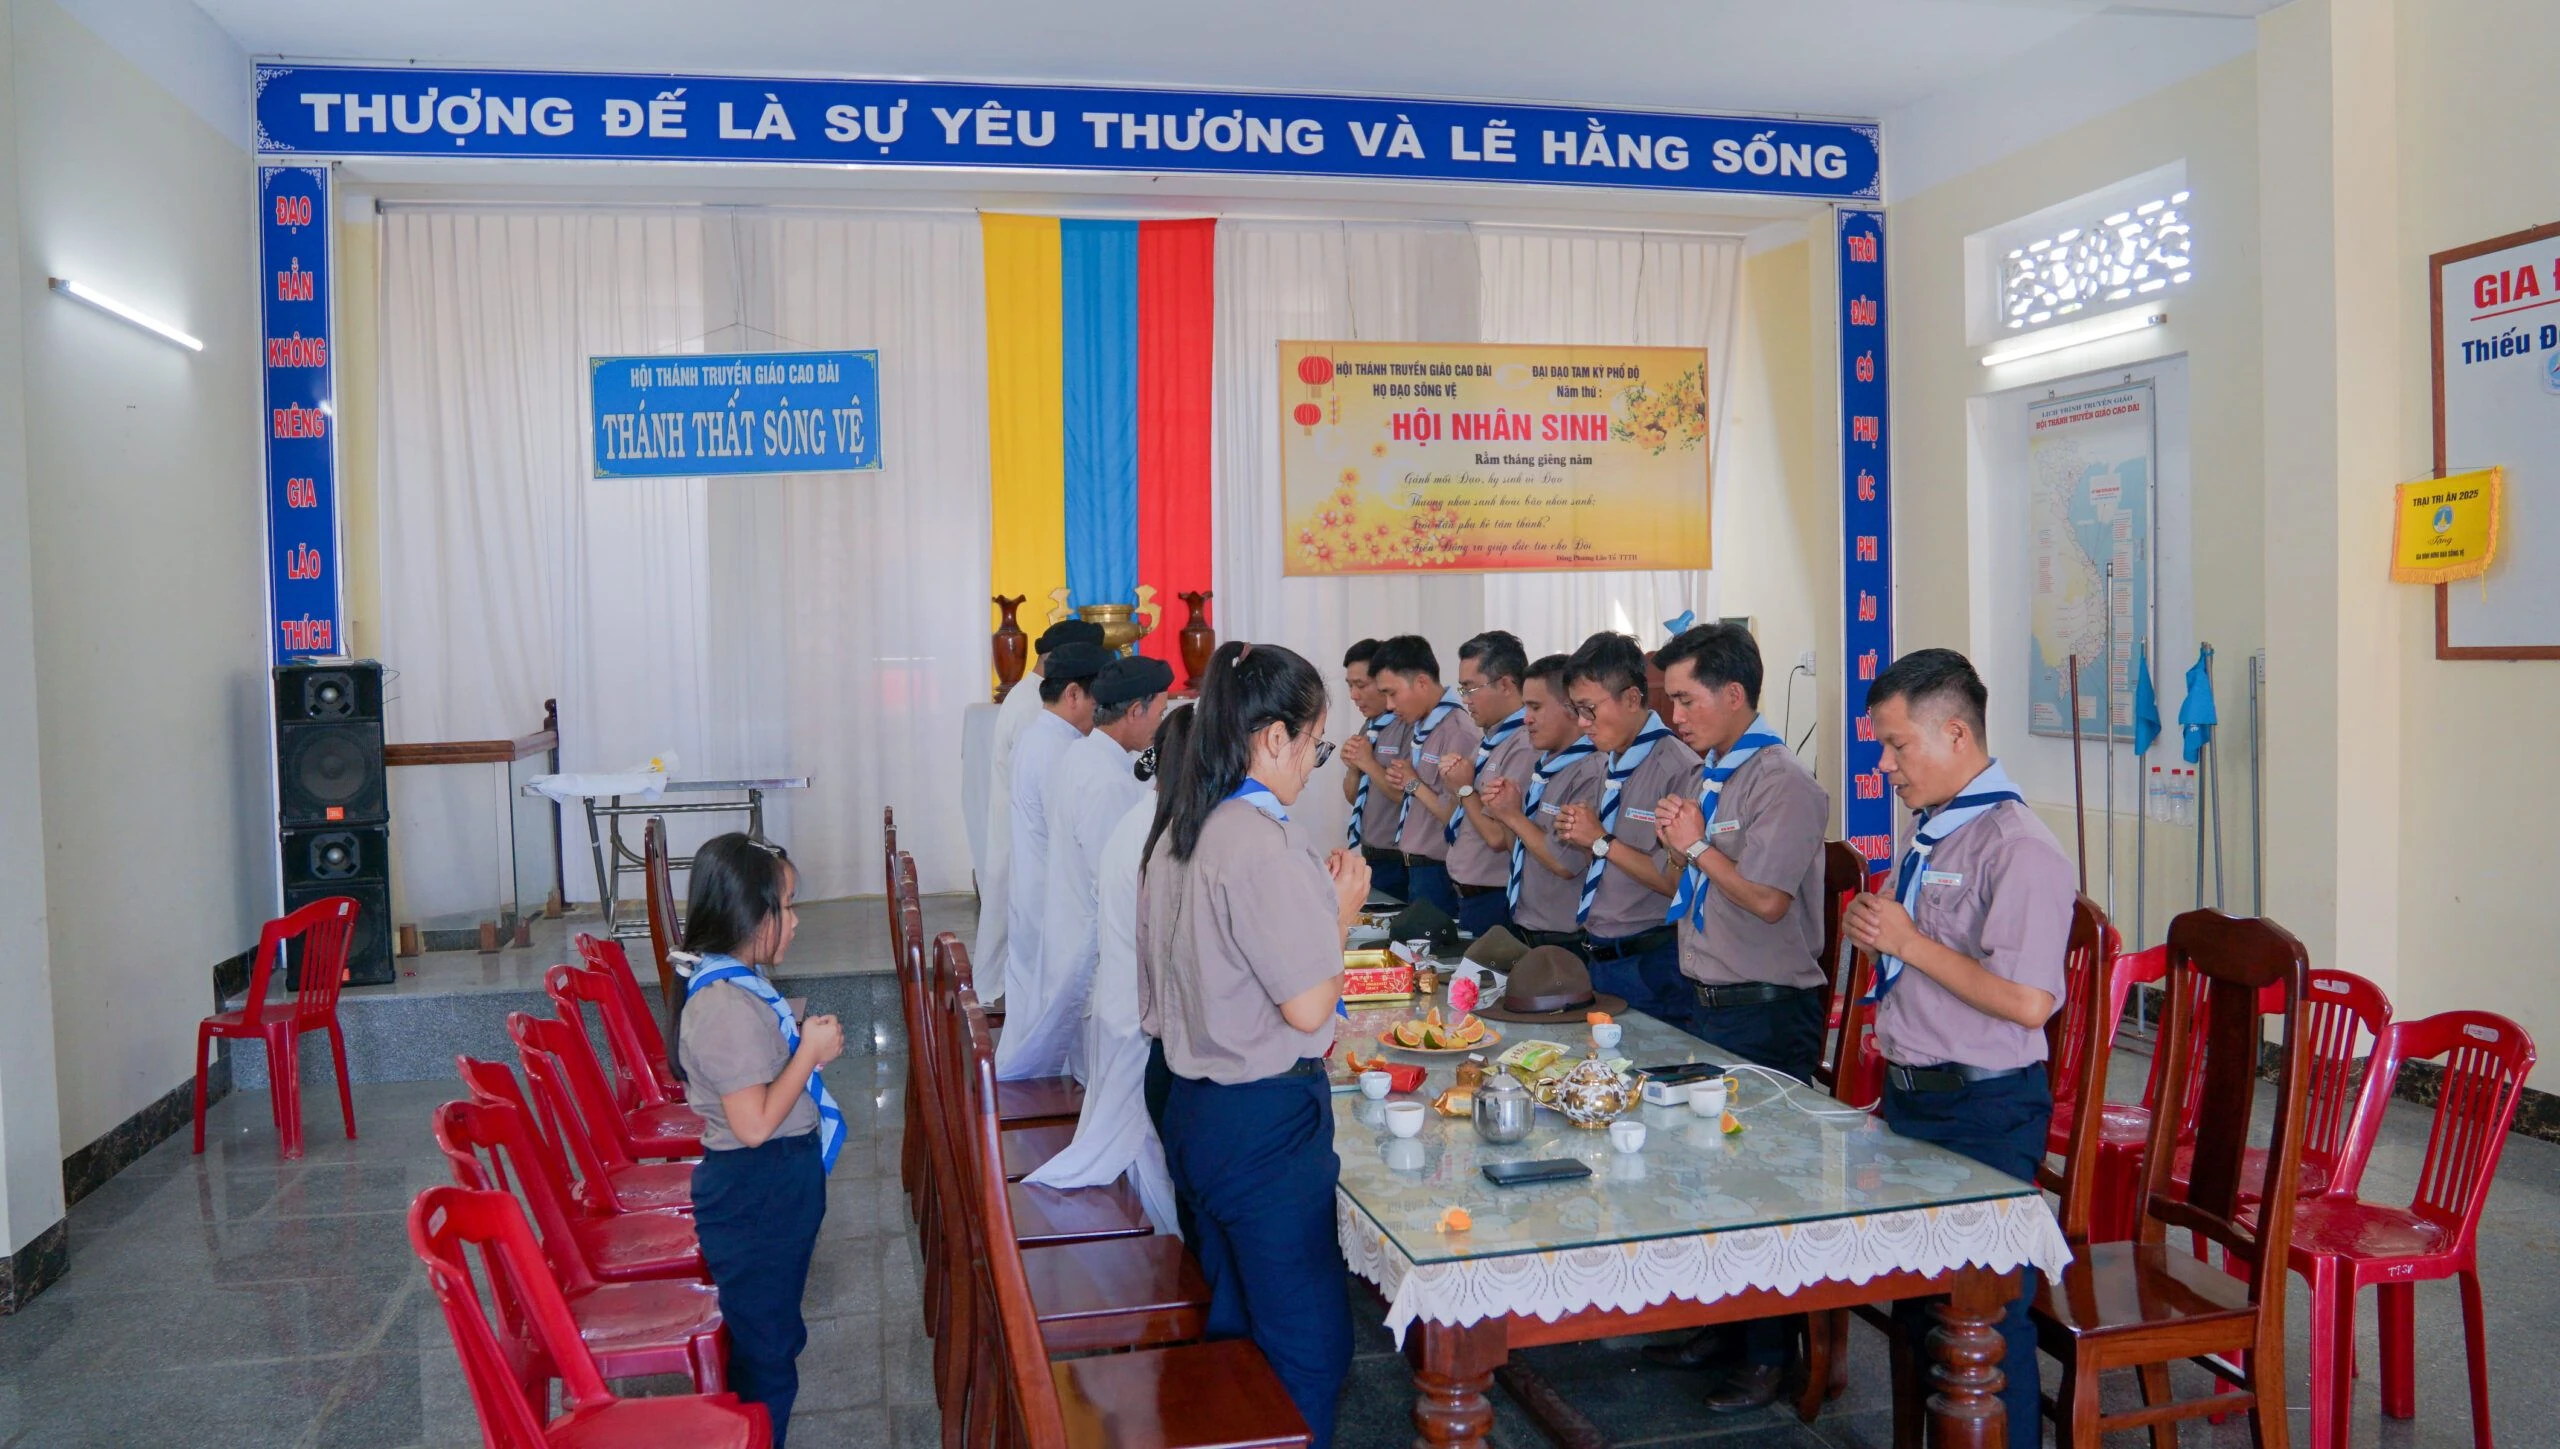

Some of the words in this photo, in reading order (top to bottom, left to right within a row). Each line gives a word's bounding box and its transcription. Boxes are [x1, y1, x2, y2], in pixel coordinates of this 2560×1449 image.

[301, 87, 574, 146] THƯỢNG
[602, 88, 687, 138] ĐẾ
[719, 93, 796, 141] LÀ
[824, 100, 908, 154] SỰ
[931, 101, 1055, 146] YÊU
[1083, 109, 1324, 154] THƯƠNG
[1348, 114, 1425, 159] VÀ
[1451, 119, 1516, 162] LẼ
[1543, 117, 1689, 171] HẰNG
[1712, 131, 1847, 179] SỐNG
[276, 196, 312, 234] ĐẠO
[1848, 231, 1877, 262] TRỜI
[278, 257, 313, 301] HẲN
[2474, 265, 2540, 310] GIA
[1851, 294, 1876, 326] ĐÂU
[268, 331, 326, 367] KHÔNG
[2462, 327, 2530, 364] Thiếu
[2540, 324, 2560, 350] Đ
[631, 363, 652, 391] HỘI
[656, 363, 698, 387] THÁNH
[702, 360, 751, 386] TRUYỀN
[755, 362, 785, 385] GIÁO
[788, 363, 814, 384] CAO
[817, 360, 840, 383] ĐÀI
[1336, 361, 1352, 378] HỘI
[1355, 361, 1387, 376] THÁNH
[1390, 360, 1427, 376] TRUYỀN
[1430, 361, 1451, 376] GIÁO
[1455, 363, 1473, 377] CAO
[1476, 362, 1492, 377] ĐÀI
[1532, 365, 1548, 380] ĐẠI
[1551, 366, 1569, 381] ĐẠO
[1572, 366, 1590, 379] TAM
[1592, 364, 1605, 379] KỲ
[1607, 362, 1625, 379] PHỔ
[1628, 365, 1640, 381] ĐỘ
[1856, 350, 1874, 382] CÓ
[1373, 384, 1386, 399] HỌ
[1390, 384, 1410, 399] ĐẠO
[1414, 382, 1441, 397] SÔNG
[1445, 382, 1457, 399] VỆ
[1557, 385, 1579, 398] Năm
[1581, 385, 1597, 398] thứ
[274, 402, 324, 438] RIÊNG
[602, 399, 686, 460] THÁNH
[692, 387, 755, 458] THẤT
[763, 396, 826, 456] SÔNG
[832, 394, 865, 465] VỆ
[1393, 407, 1441, 446] HỘI
[1452, 408, 1531, 441] NHÂN
[1542, 413, 1608, 442] SINH
[2095, 406, 2111, 418] GIÁO
[2112, 405, 2127, 415] CAO
[1853, 416, 1878, 449] PHỤ
[1475, 451, 1500, 465] Rằm
[1504, 453, 1534, 468] tháng
[1538, 453, 1567, 468] giêng
[1570, 453, 1592, 465] năm
[287, 478, 317, 508] GIA
[1502, 473, 1521, 484] sinh
[1858, 469, 1875, 501] ÚC
[2432, 494, 2444, 504] TRI
[2459, 489, 2479, 500] 2025
[288, 543, 321, 579] LÃO
[1857, 536, 1877, 561] PHI
[1859, 590, 1876, 621] ÂU
[281, 613, 331, 649] THÍCH
[1859, 649, 1878, 680] MỸ
[1855, 767, 1883, 799] TRỜI
